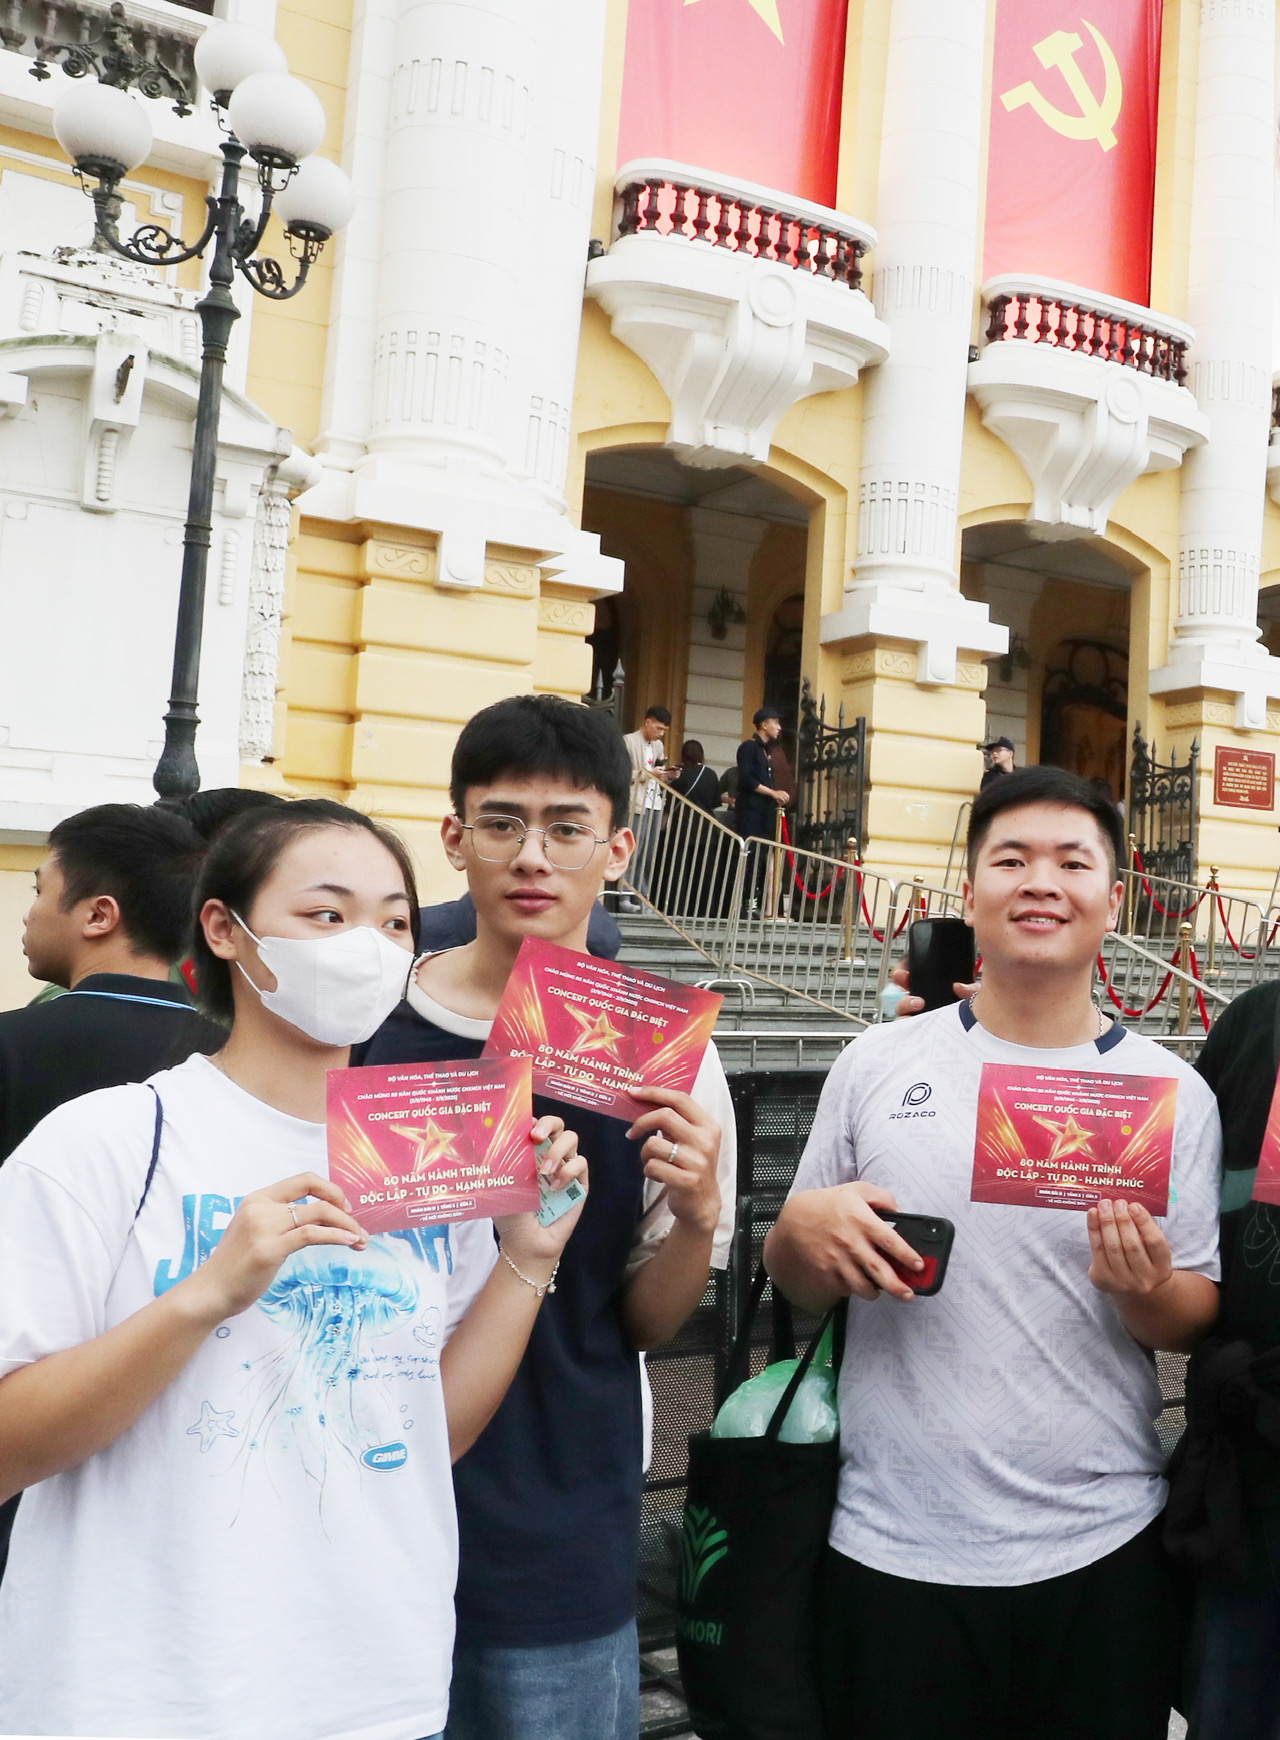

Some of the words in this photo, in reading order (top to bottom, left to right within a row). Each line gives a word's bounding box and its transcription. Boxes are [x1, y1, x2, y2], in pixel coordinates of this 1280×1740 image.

[546, 985, 588, 1004] CONCERT
[586, 994, 615, 1012] QUỐC
[613, 1005, 630, 1016] GIA
[629, 1008, 650, 1024] ĐẶC
[648, 1014, 669, 1029] BIỆT
[533, 1054, 557, 1071] LẬP
[561, 1064, 578, 1078] TỰ
[577, 1069, 595, 1081] DO
[537, 1043, 554, 1055] 80
[554, 1046, 580, 1063] NĂM
[579, 1053, 612, 1072] HÀNH
[612, 1063, 645, 1082] TRÌNH
[367, 1109, 410, 1121] CONCERT
[411, 1104, 437, 1118] QUỐC
[438, 1105, 453, 1115] GIA
[454, 1102, 473, 1115] ĐẶC
[473, 1100, 492, 1113] BIỆT
[1014, 1102, 1053, 1112] CONCERT
[1053, 1103, 1079, 1115] QUỐC
[1079, 1107, 1094, 1115] GIA
[1095, 1107, 1113, 1118] ĐẶC
[1114, 1108, 1132, 1120] BIỆT
[383, 1175, 399, 1186] 80
[401, 1170, 426, 1184] NĂM
[427, 1165, 458, 1181] HÀNH
[460, 1162, 490, 1177] TRÌNH
[995, 1166, 1018, 1180] ĐỘC
[1019, 1168, 1039, 1181] LẬP
[1046, 1172, 1060, 1183] TỰ
[1061, 1173, 1077, 1182] DO
[1084, 1175, 1113, 1187] HẠNH
[1115, 1176, 1144, 1188] PHÚC
[1019, 1157, 1034, 1166] 80
[1035, 1157, 1059, 1169] NĂM
[1060, 1159, 1090, 1171] HÀNH
[1091, 1162, 1122, 1174] TRÌNH
[359, 1189, 385, 1207] ĐỘC
[386, 1186, 408, 1203] LẬP
[415, 1185, 430, 1199] TỰ
[431, 1183, 447, 1194] DO
[455, 1178, 485, 1194] HẠNH
[486, 1172, 515, 1187] PHÚC
